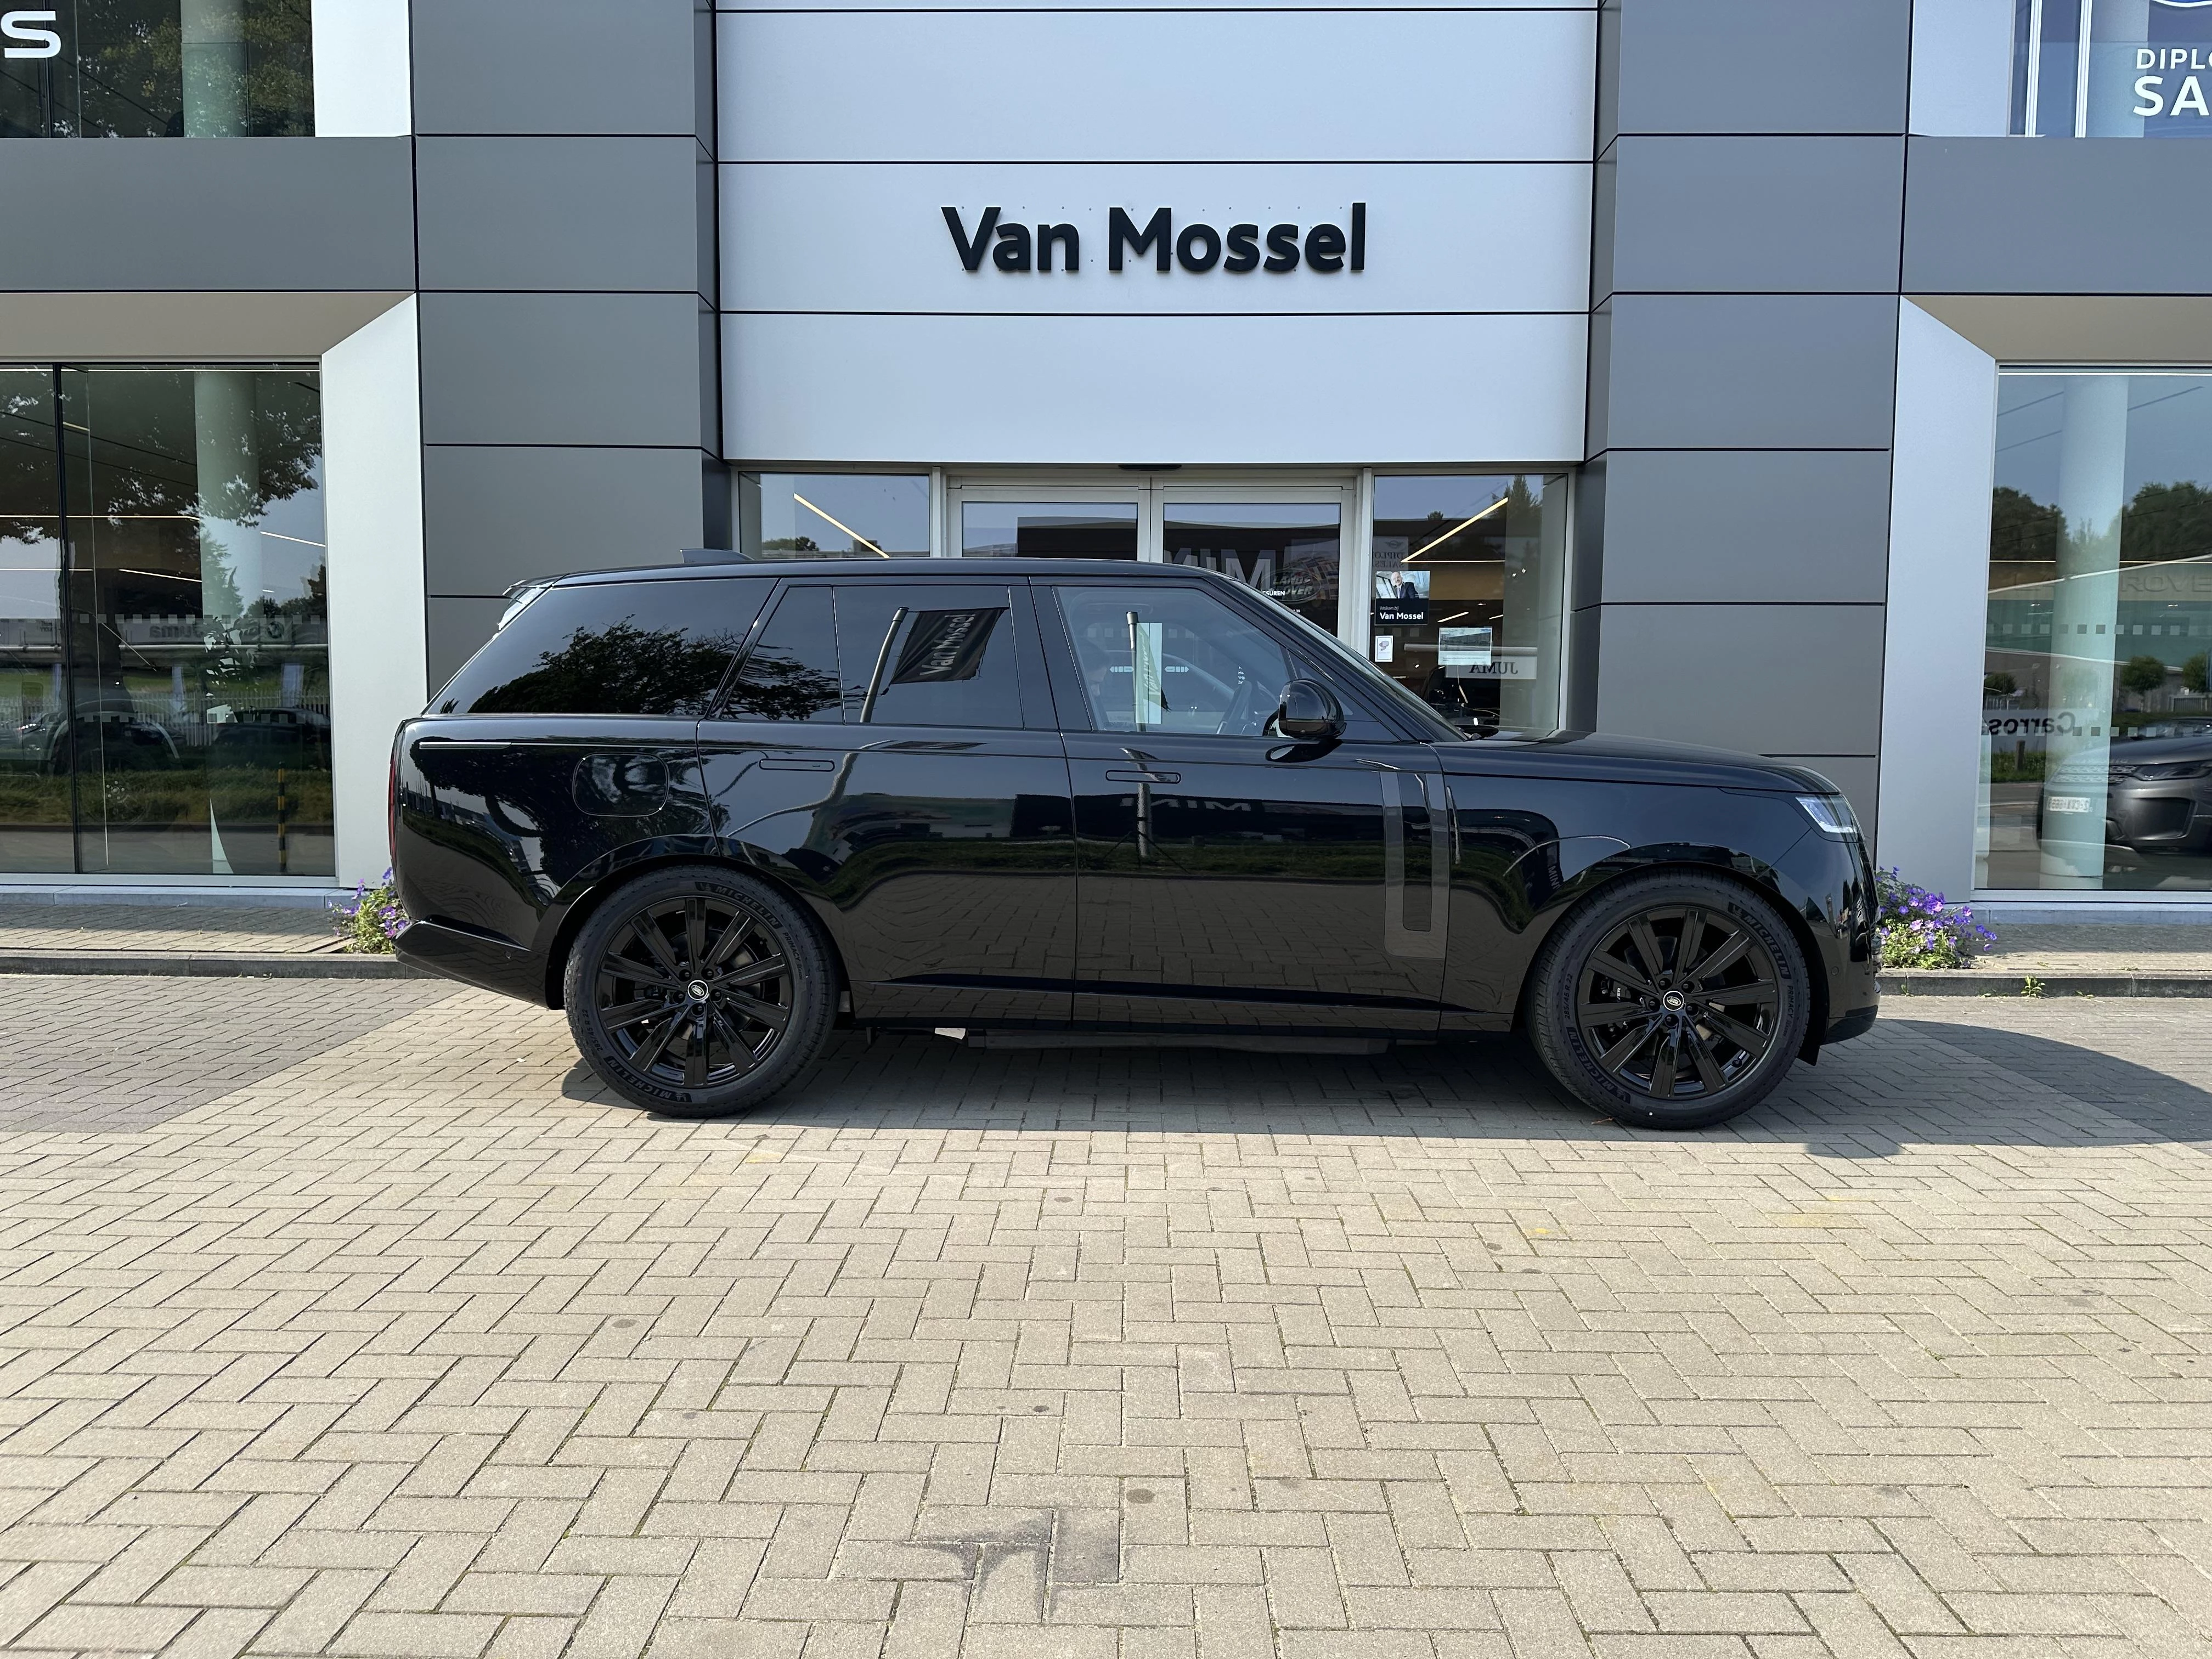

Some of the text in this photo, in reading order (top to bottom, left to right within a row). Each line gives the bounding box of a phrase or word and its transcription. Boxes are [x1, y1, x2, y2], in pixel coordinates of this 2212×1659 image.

[1, 10, 61, 58] S
[2136, 48, 2212, 69] DIPL
[2133, 75, 2210, 116] SA
[940, 202, 1367, 272] Van Mossel
[715, 886, 779, 926] MICHELIN
[782, 932, 801, 962] PRIMACY
[1743, 915, 1790, 975] MICHELIN
[1566, 974, 1573, 984] 22
[587, 1027, 603, 1052] 285/45
[607, 1059, 673, 1099] MICHELIN
[1568, 1031, 1615, 1091] MICHELIN
